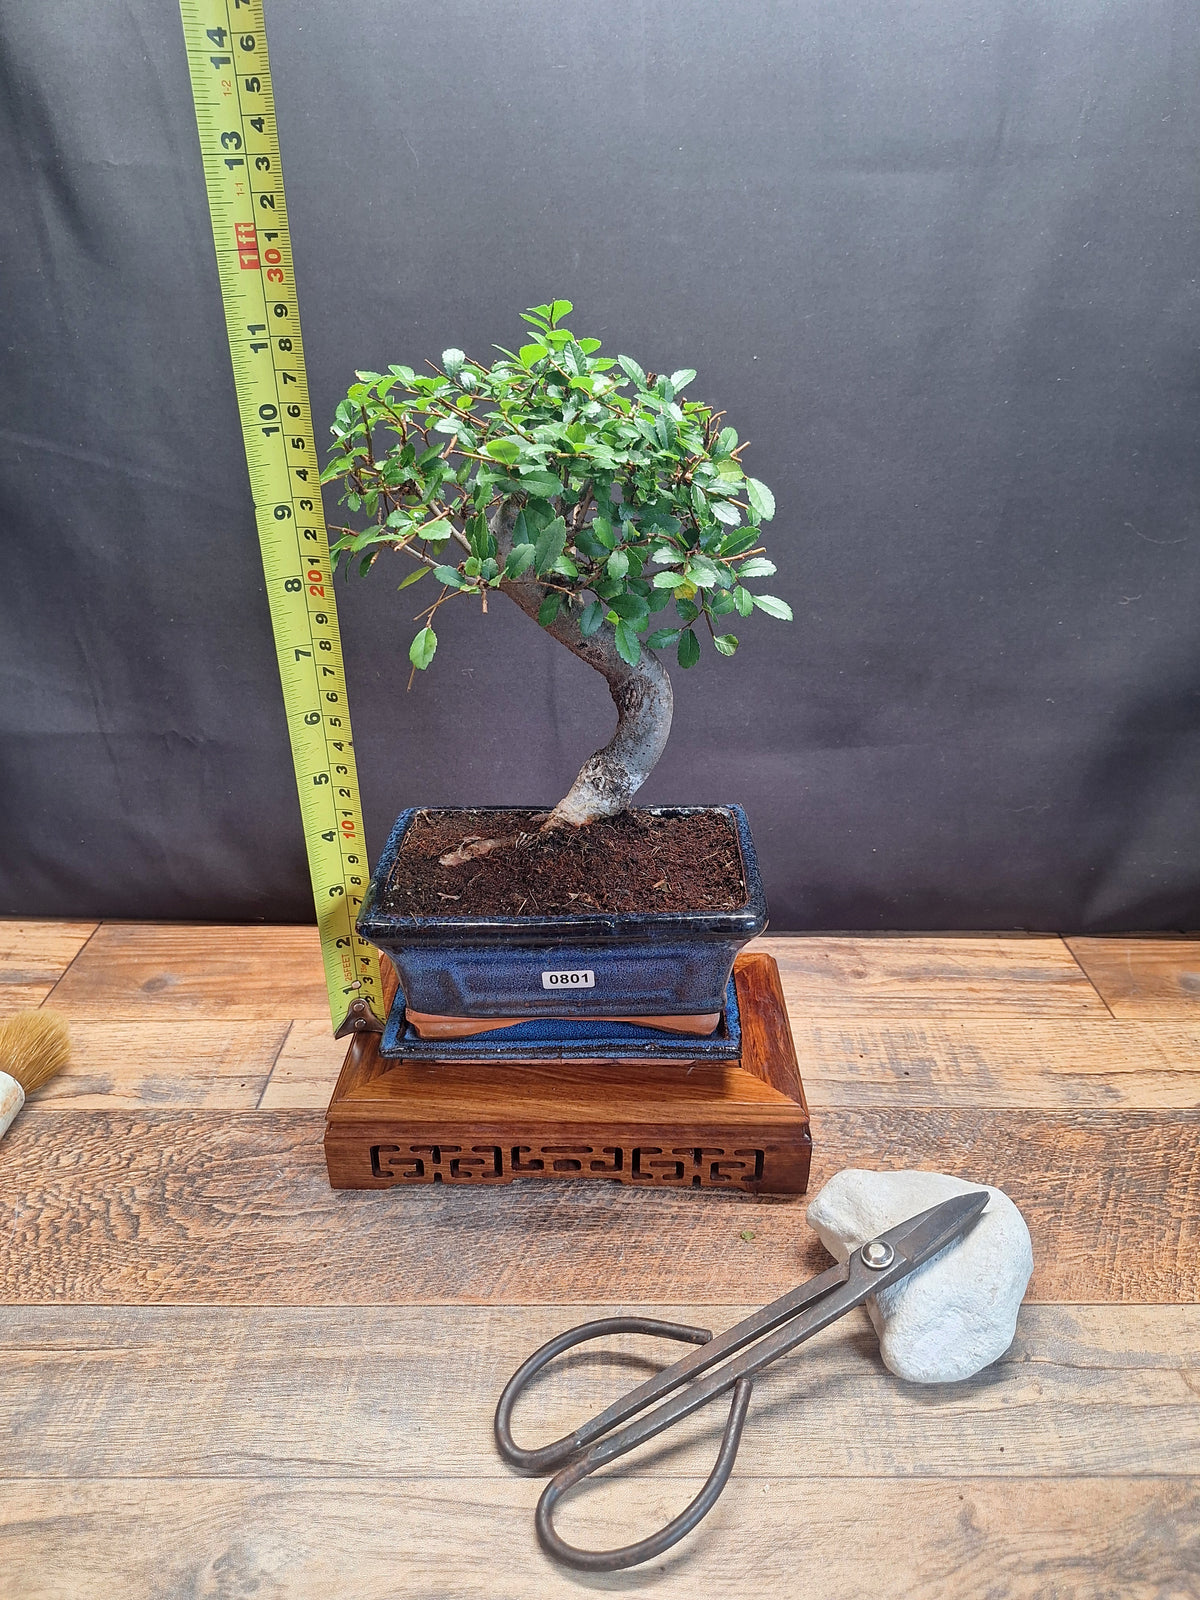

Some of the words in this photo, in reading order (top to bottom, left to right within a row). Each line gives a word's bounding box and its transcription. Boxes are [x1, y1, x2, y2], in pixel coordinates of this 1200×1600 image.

[206, 26, 231, 70] 14
[240, 35, 255, 51] 6
[246, 77, 260, 92] 5
[250, 117, 264, 132] 4
[221, 132, 244, 170] 13
[256, 157, 270, 171] 3
[260, 195, 275, 209] 2
[265, 232, 278, 242] 1
[265, 248, 284, 282] 30
[274, 304, 288, 318] 9
[247, 324, 268, 354] 11
[278, 338, 292, 352] 8
[282, 372, 296, 384] 7
[287, 405, 301, 418] 6
[258, 404, 280, 437] 10
[292, 438, 305, 450] 5
[296, 468, 309, 482] 4
[274, 504, 292, 520] 9
[300, 500, 313, 512] 3
[304, 529, 317, 540] 2
[308, 558, 320, 566] 1
[284, 578, 302, 592] 8
[308, 570, 324, 598] 20
[316, 613, 328, 624] 9
[320, 640, 332, 651] 8
[295, 648, 312, 662] 7
[322, 666, 335, 677] 7
[326, 692, 338, 702] 6
[304, 712, 321, 726] 6
[330, 718, 342, 728] 5
[333, 742, 344, 752] 4
[336, 765, 348, 775] 3
[313, 773, 330, 786] 5
[339, 788, 350, 798] 2
[322, 830, 336, 842] 4
[341, 820, 356, 840] 10
[348, 855, 359, 864] 9
[350, 876, 362, 886] 8
[329, 886, 344, 898] 3
[353, 897, 362, 906] 7
[336, 936, 350, 948] 2
[360, 957, 371, 966] 4
[363, 976, 374, 984] 3
[550, 973, 588, 984] 0801
[364, 996, 376, 1004] 2
